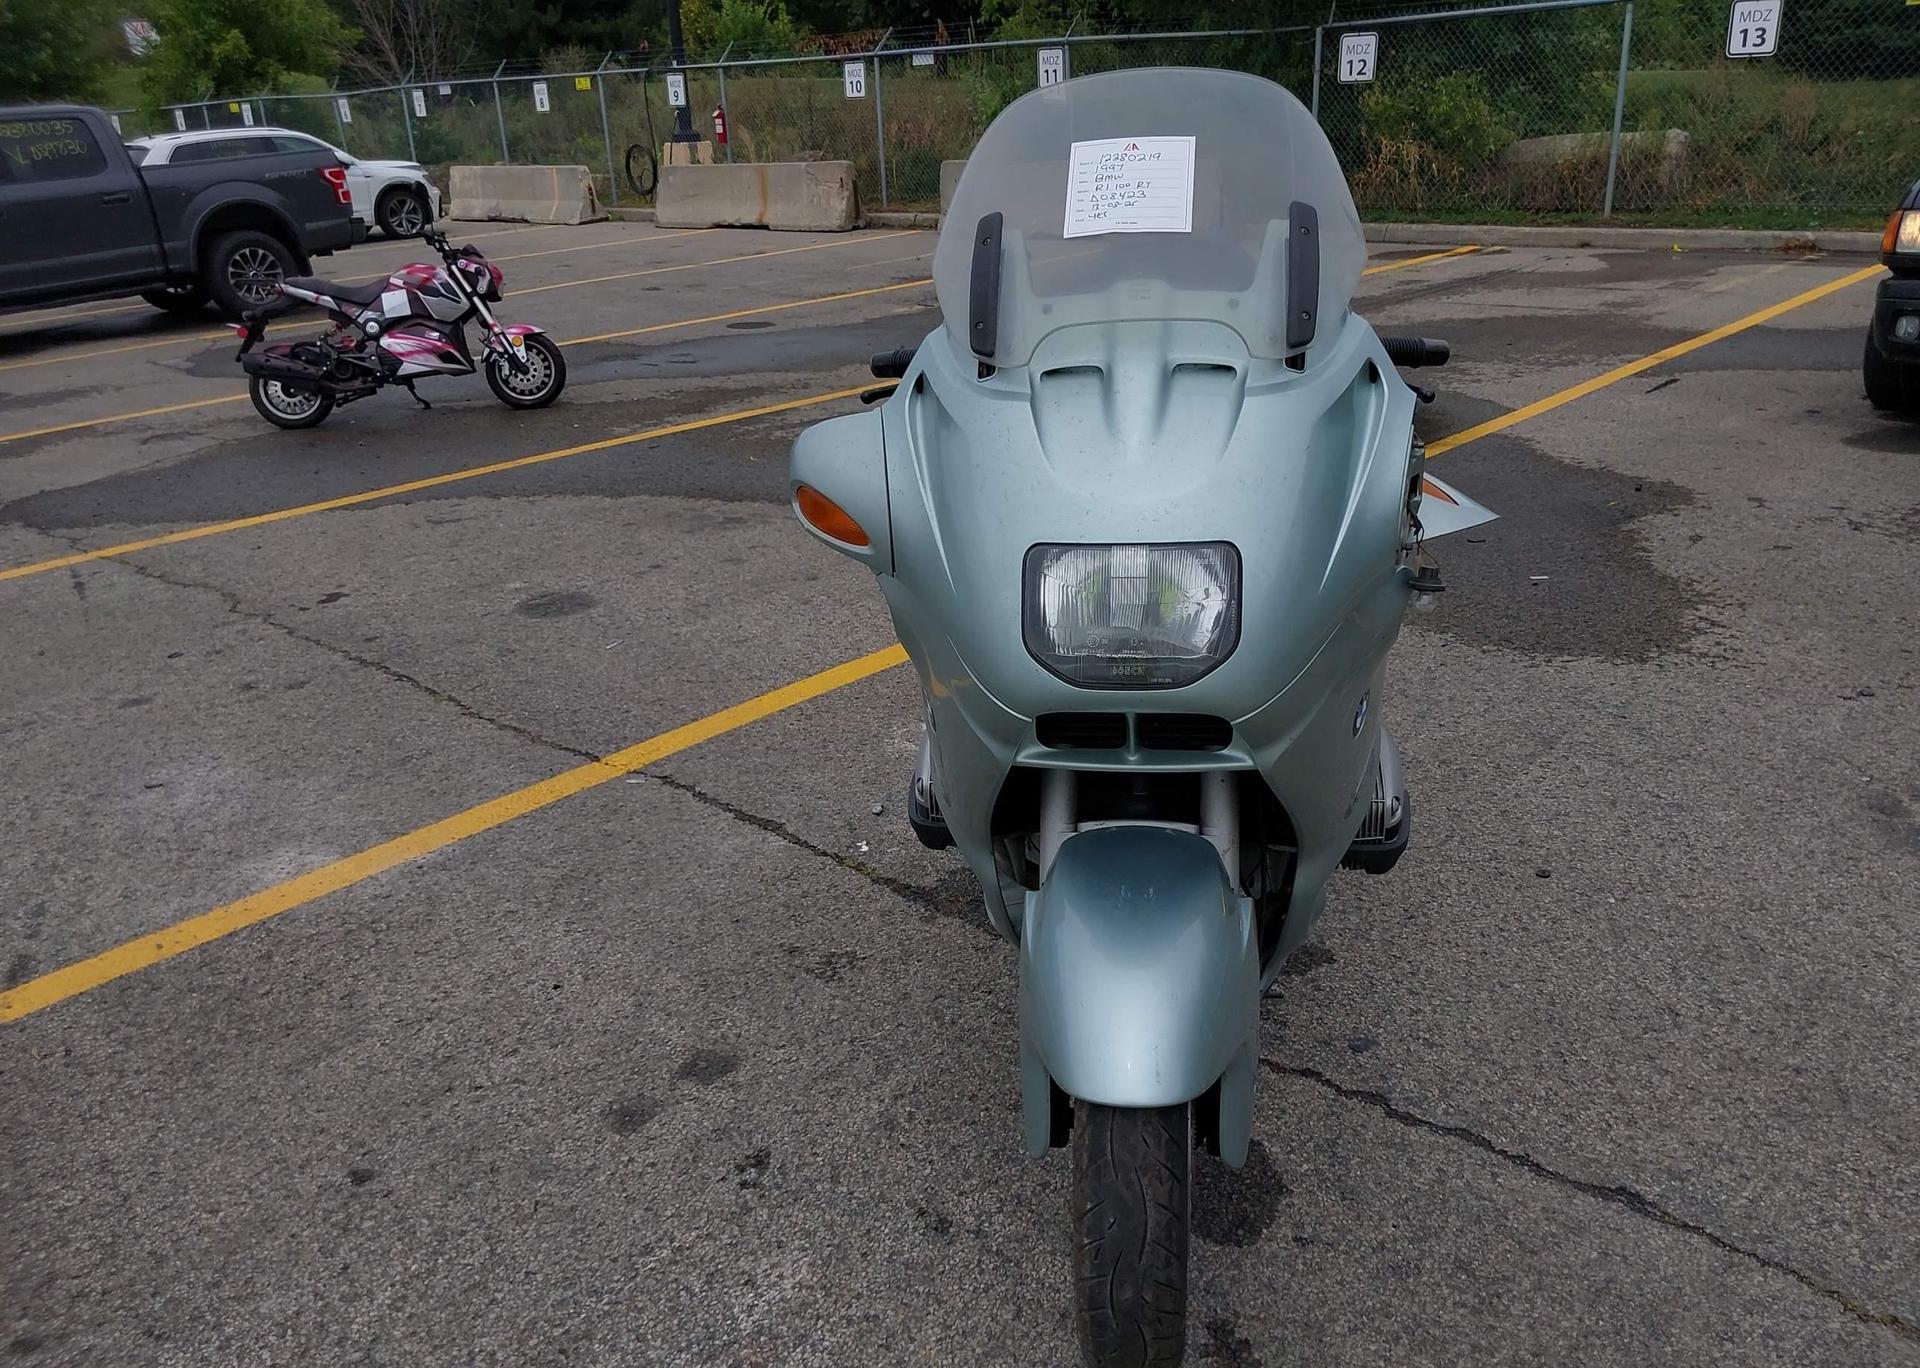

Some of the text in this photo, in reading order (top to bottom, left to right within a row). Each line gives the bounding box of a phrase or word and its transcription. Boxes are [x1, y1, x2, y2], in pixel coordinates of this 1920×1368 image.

[1739, 9, 1773, 23] MDZ
[1739, 27, 1767, 48] 13
[1346, 43, 1370, 55] MDZ
[1042, 55, 1060, 65] MDZ
[847, 69, 863, 78] MDZ
[1346, 59, 1367, 76] 12
[1044, 69, 1058, 83] 11
[849, 80, 862, 94] 10
[673, 90, 679, 102] 9
